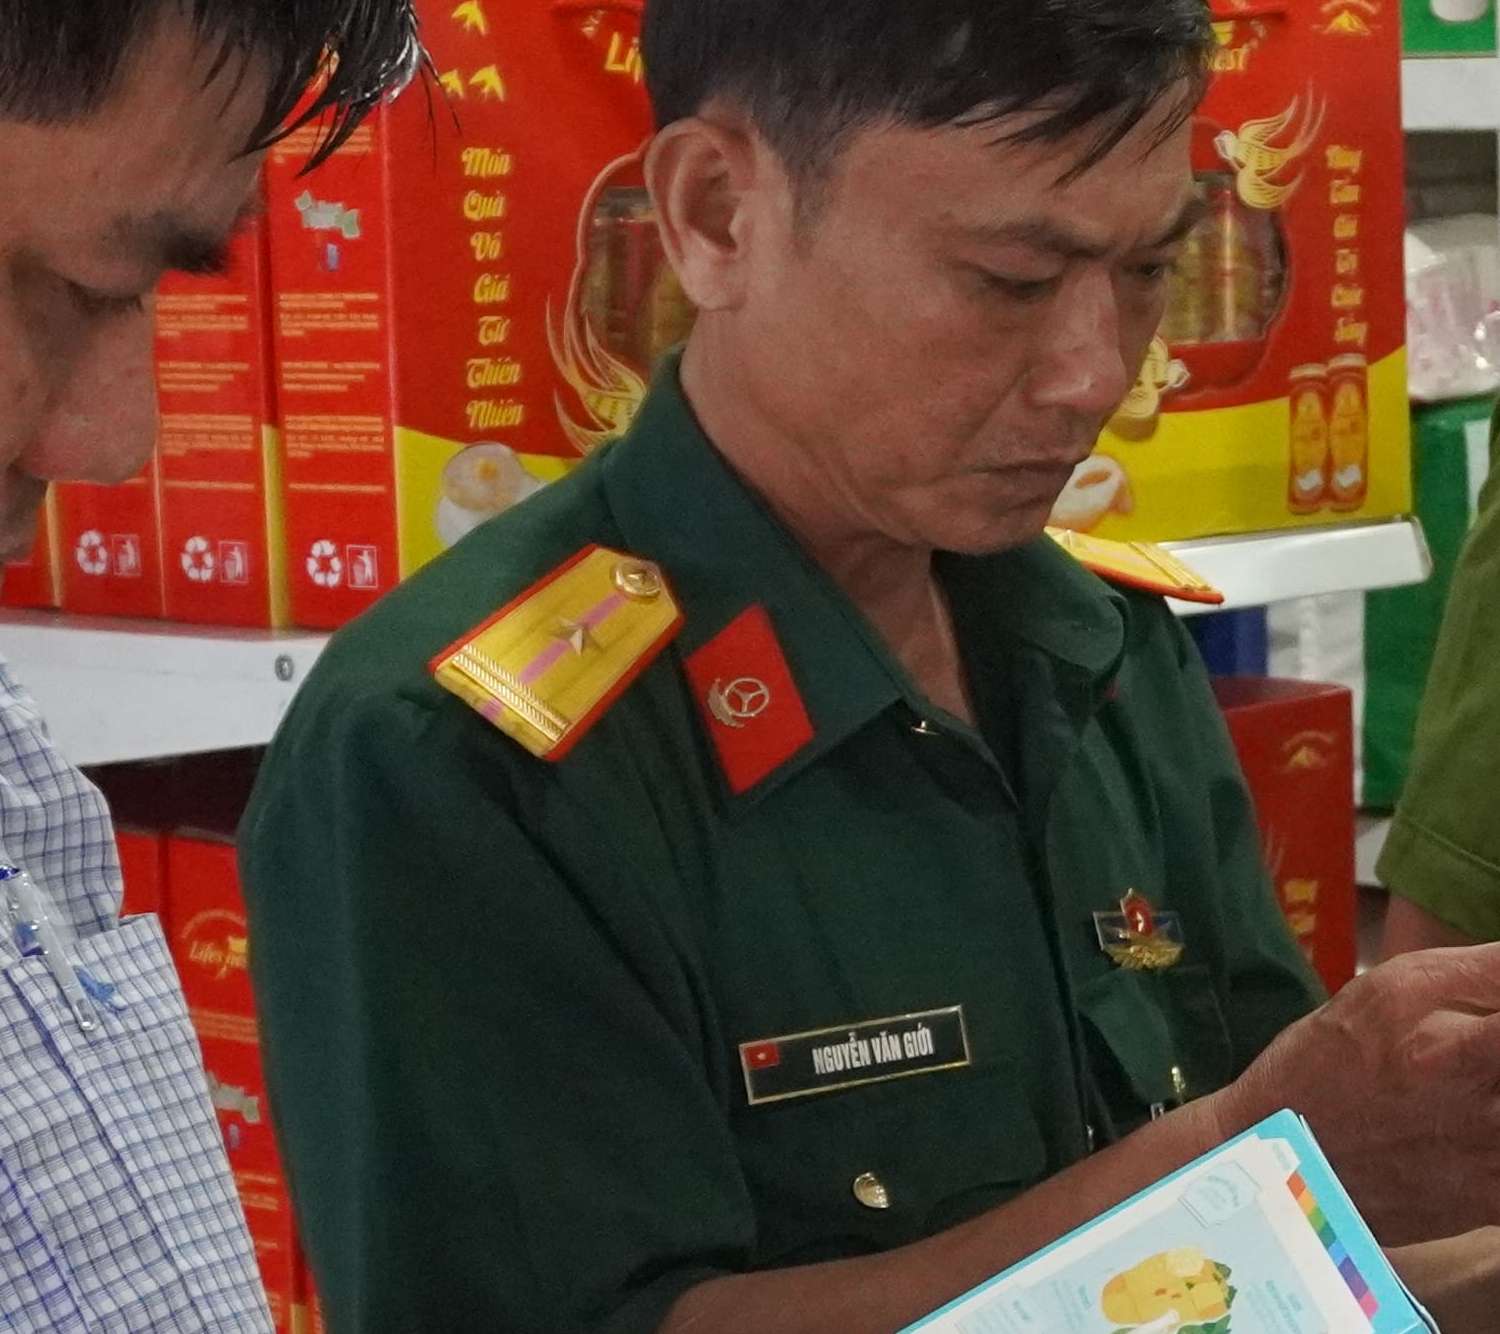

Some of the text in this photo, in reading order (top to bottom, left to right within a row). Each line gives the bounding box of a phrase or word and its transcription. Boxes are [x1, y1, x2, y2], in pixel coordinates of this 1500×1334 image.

[812, 1023, 936, 1075] NGUYỄN VĂN GIỚI
